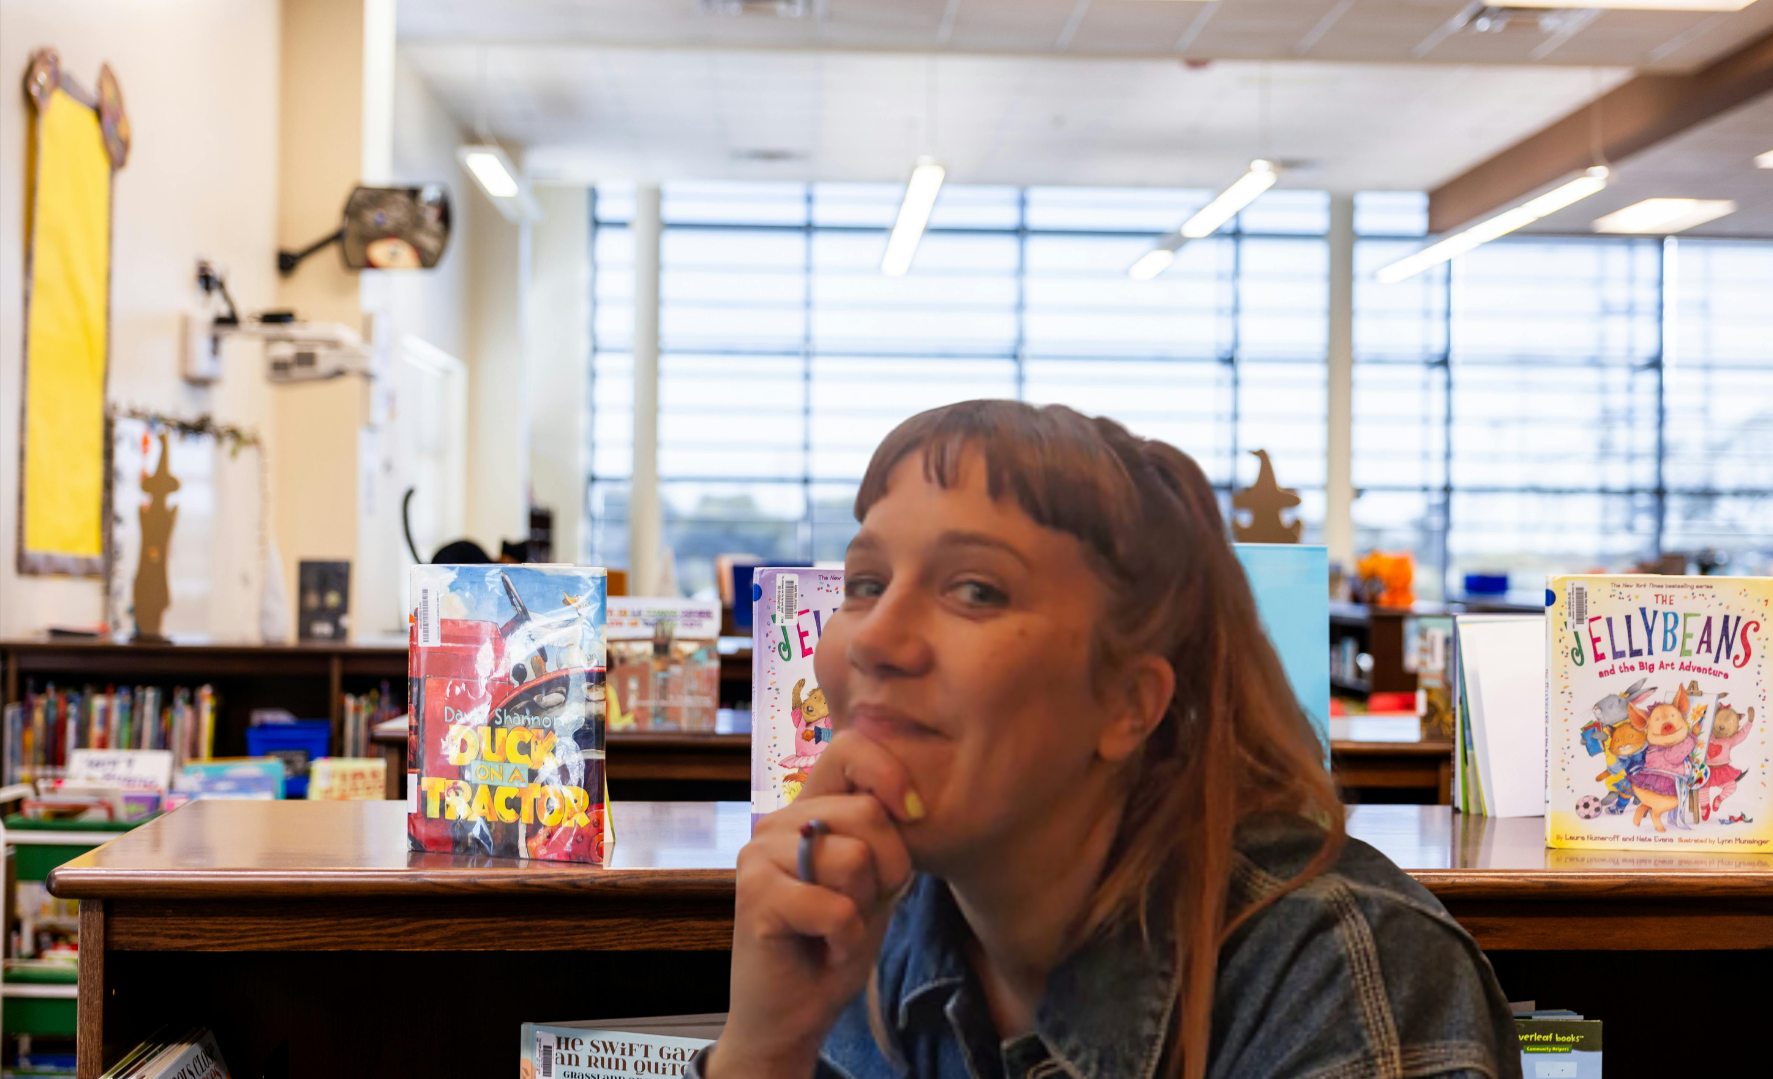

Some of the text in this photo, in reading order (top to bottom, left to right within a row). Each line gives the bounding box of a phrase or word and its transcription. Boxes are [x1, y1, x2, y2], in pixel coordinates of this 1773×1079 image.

[1654, 594, 1675, 606] THE
[1564, 606, 1761, 669] JELLYBEANS
[1598, 660, 1729, 679] and the Big Art Adventure
[448, 725, 559, 770] DUCK
[476, 764, 526, 784] ON A
[420, 776, 591, 828] TRACTOR
[1587, 834, 1620, 842] Numeroff
[1708, 837, 1716, 845] by
[1518, 1032, 1553, 1042] verleaf
[556, 1052, 580, 1067] an
